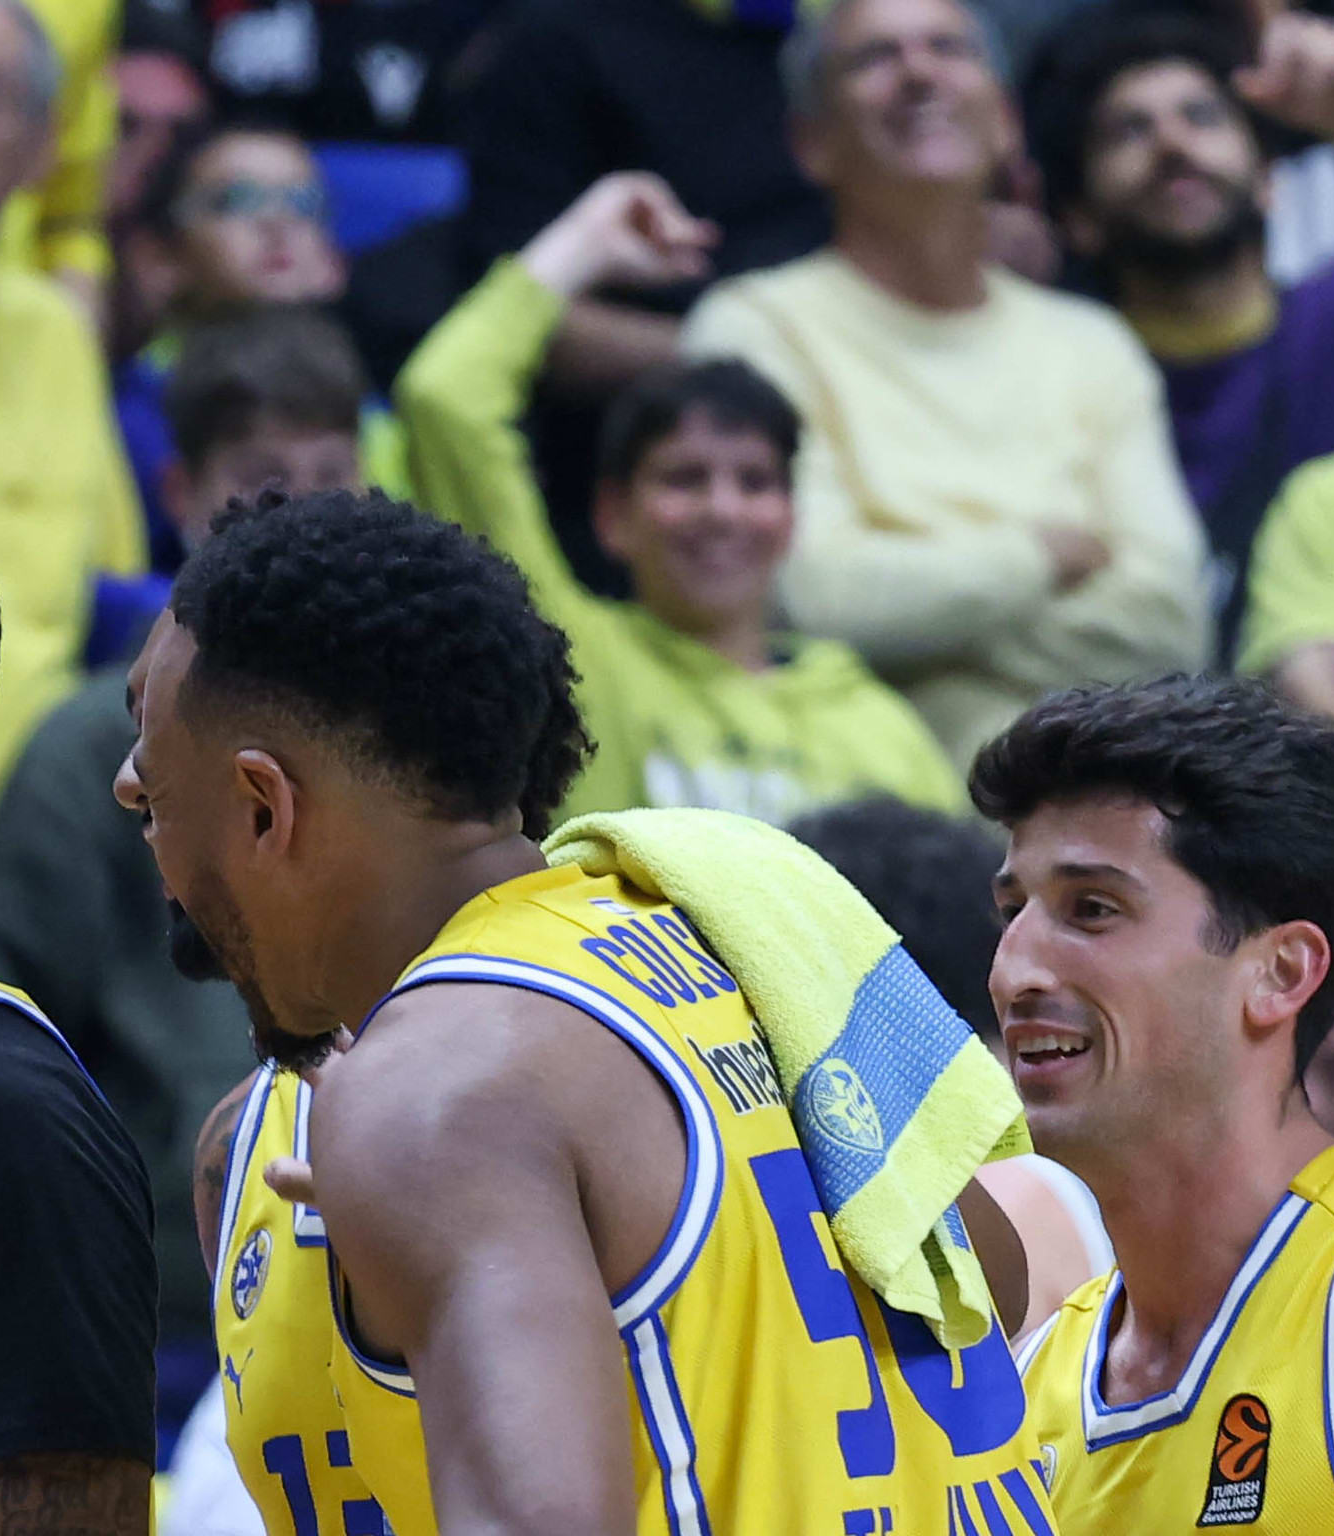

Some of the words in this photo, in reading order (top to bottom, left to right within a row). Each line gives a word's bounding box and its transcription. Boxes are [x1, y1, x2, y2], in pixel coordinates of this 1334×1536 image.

[579, 906, 737, 1009] COLS
[749, 1147, 1026, 1479] 50
[1207, 1494, 1259, 1513] AIRLINES
[1212, 1480, 1261, 1499] TURKISH
